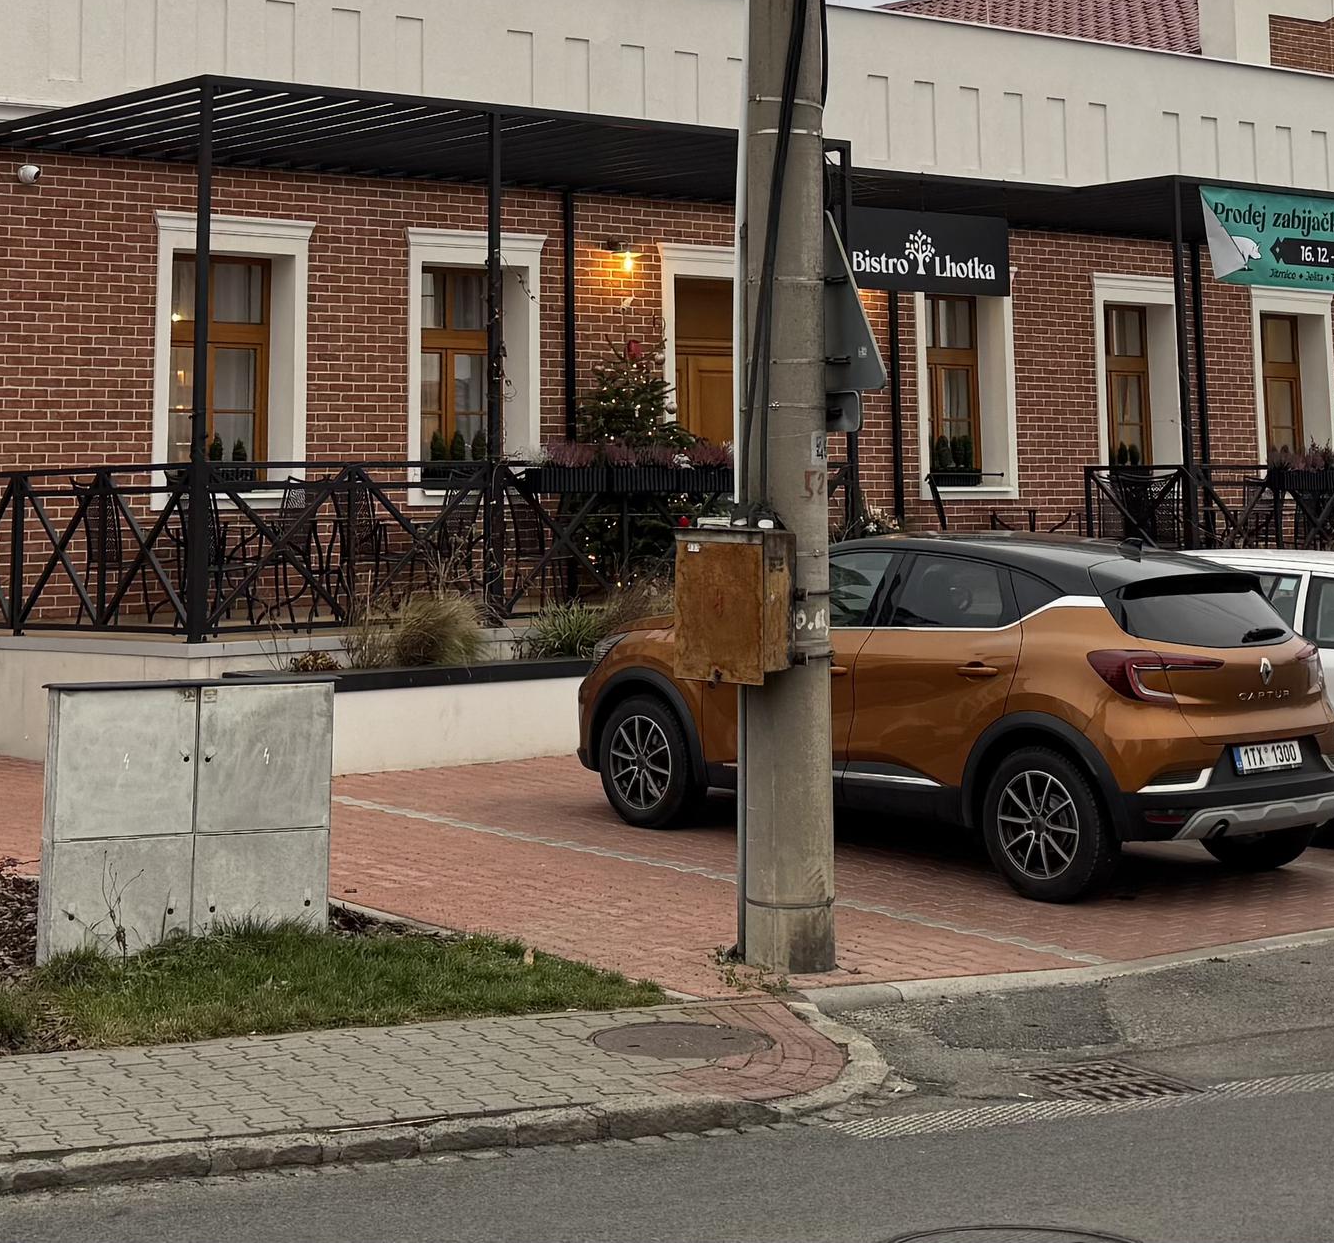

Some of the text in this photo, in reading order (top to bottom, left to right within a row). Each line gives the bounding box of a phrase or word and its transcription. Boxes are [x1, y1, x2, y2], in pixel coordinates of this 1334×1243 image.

[1214, 202, 1267, 233] Prodej
[852, 250, 996, 280] Bistro Lhotka
[1238, 689, 1290, 701] CAPTUR
[1244, 746, 1265, 767] 1TX
[1271, 743, 1297, 764] 1300
